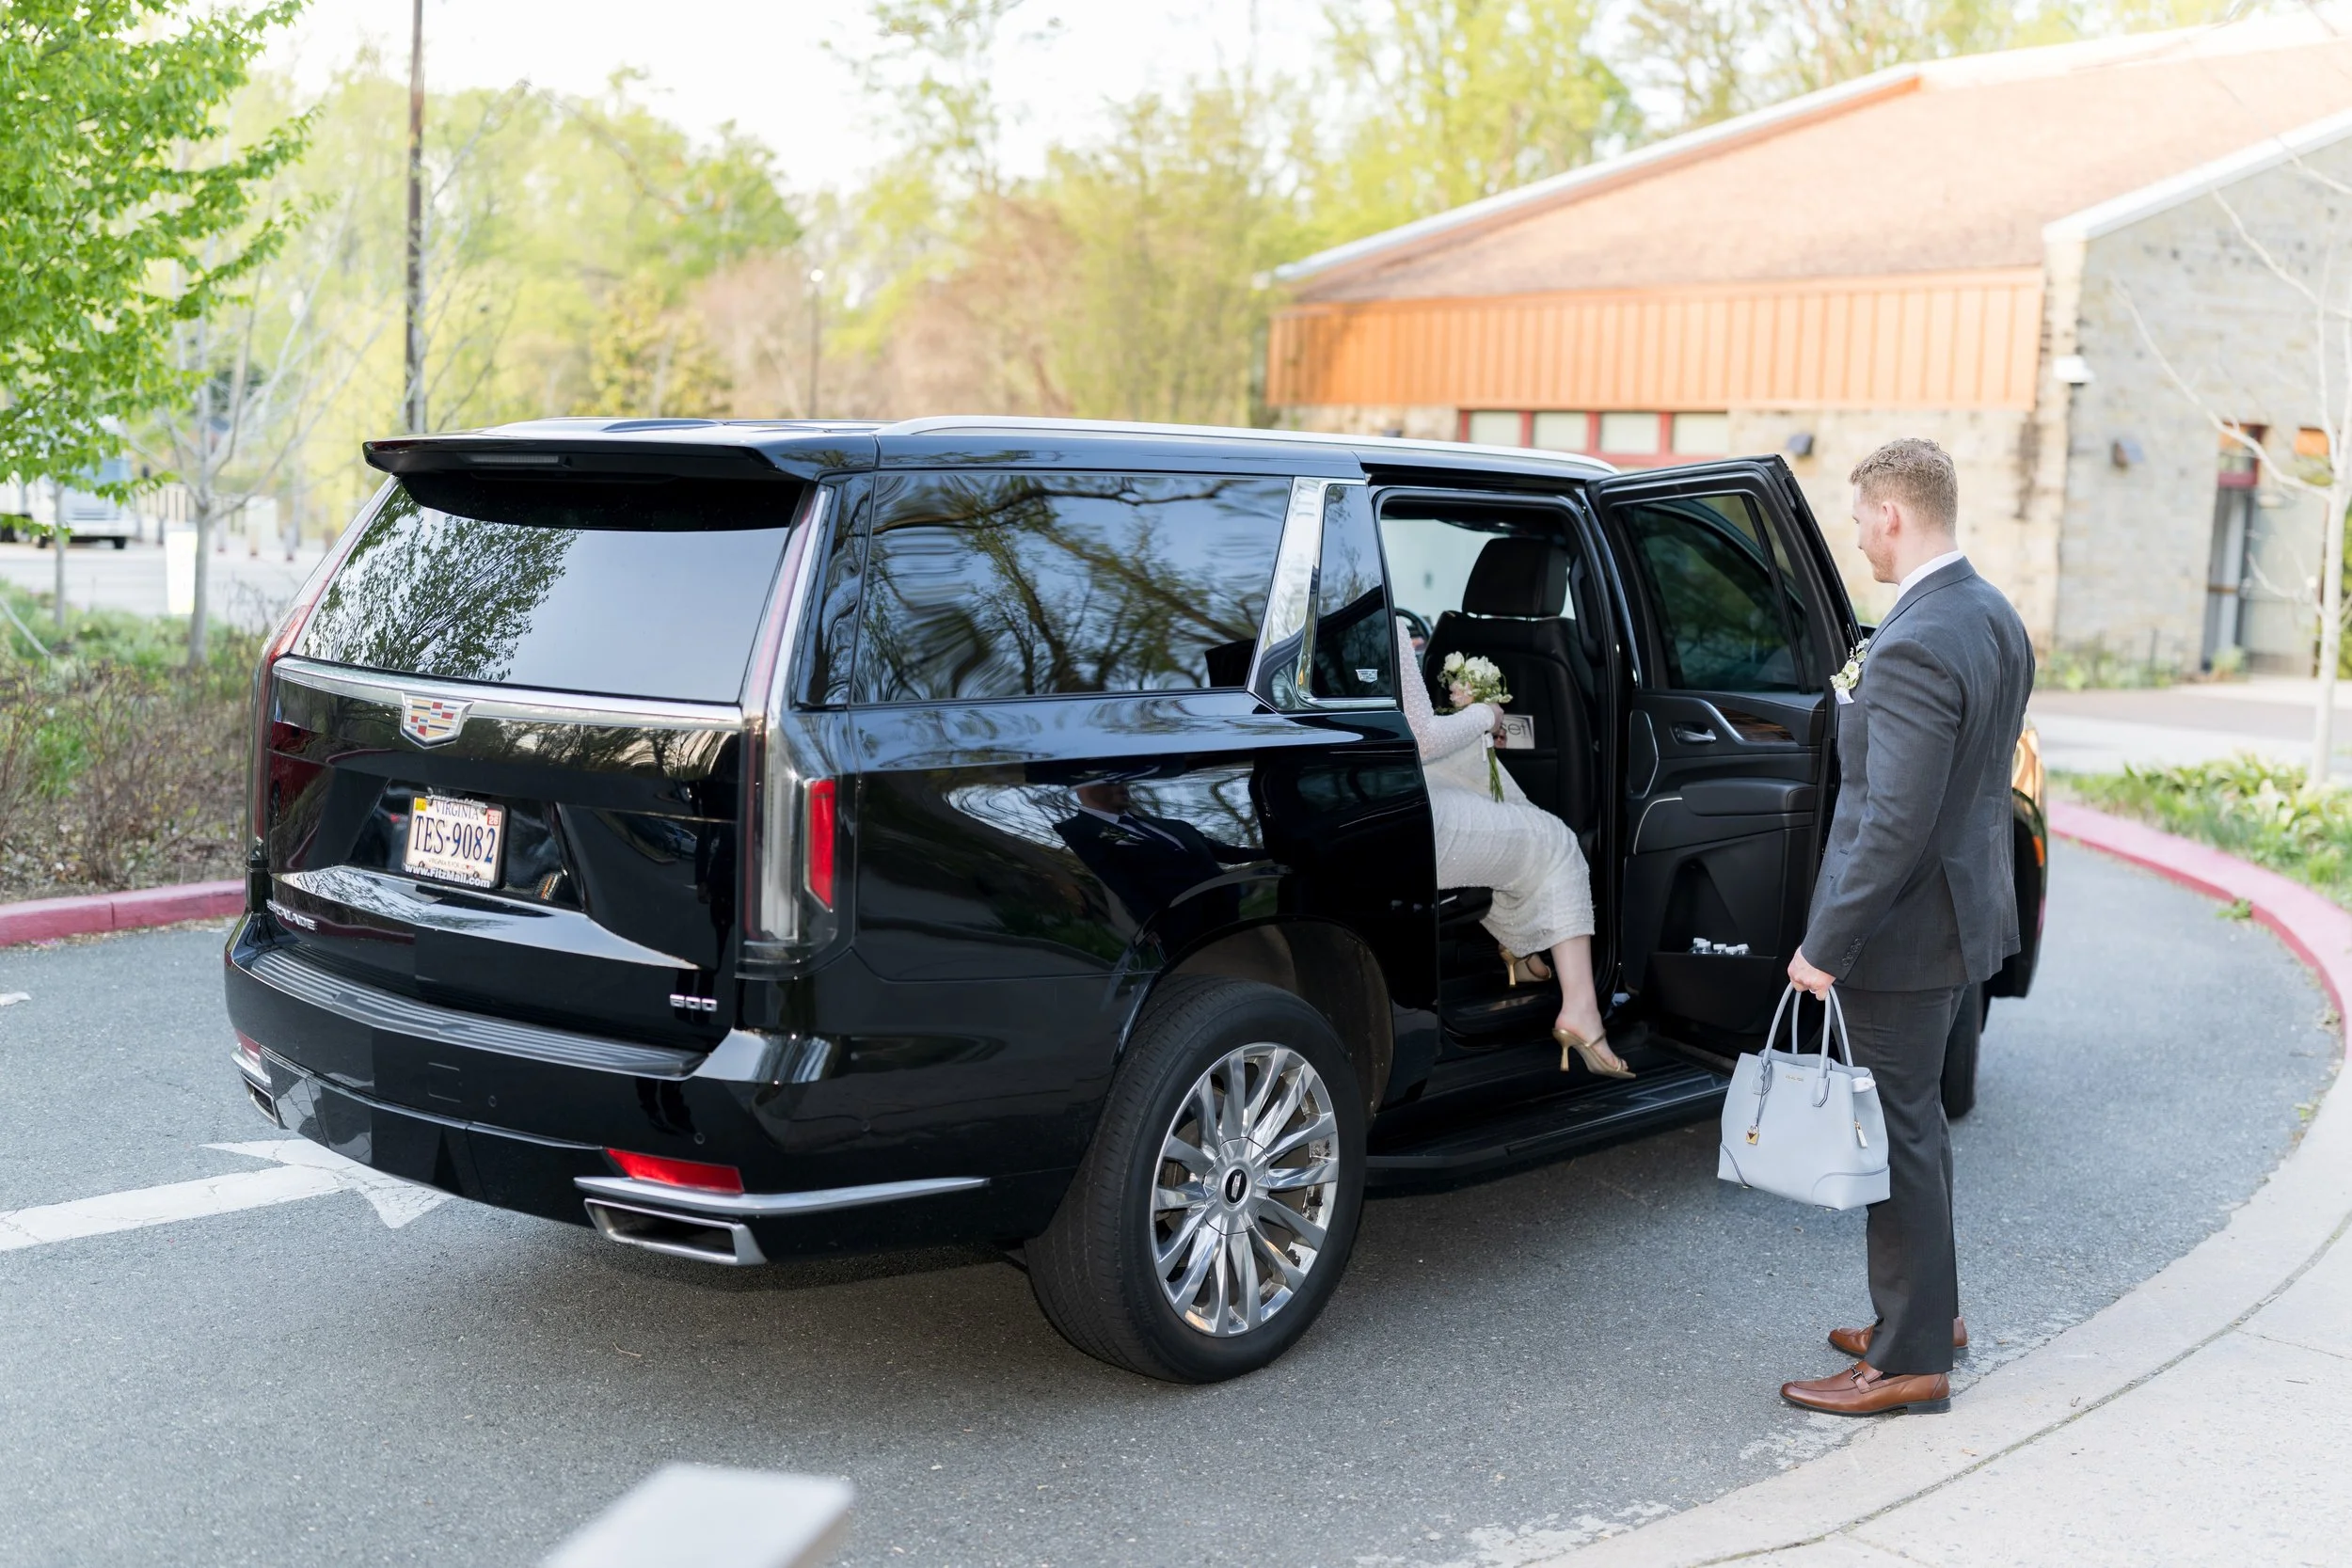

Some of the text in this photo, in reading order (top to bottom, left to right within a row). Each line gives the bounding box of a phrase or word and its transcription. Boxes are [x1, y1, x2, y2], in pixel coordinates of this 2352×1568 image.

[436, 800, 479, 820] VIRGINIA
[414, 816, 496, 864] TES-9082
[405, 864, 490, 889] www.FitzMall.com
